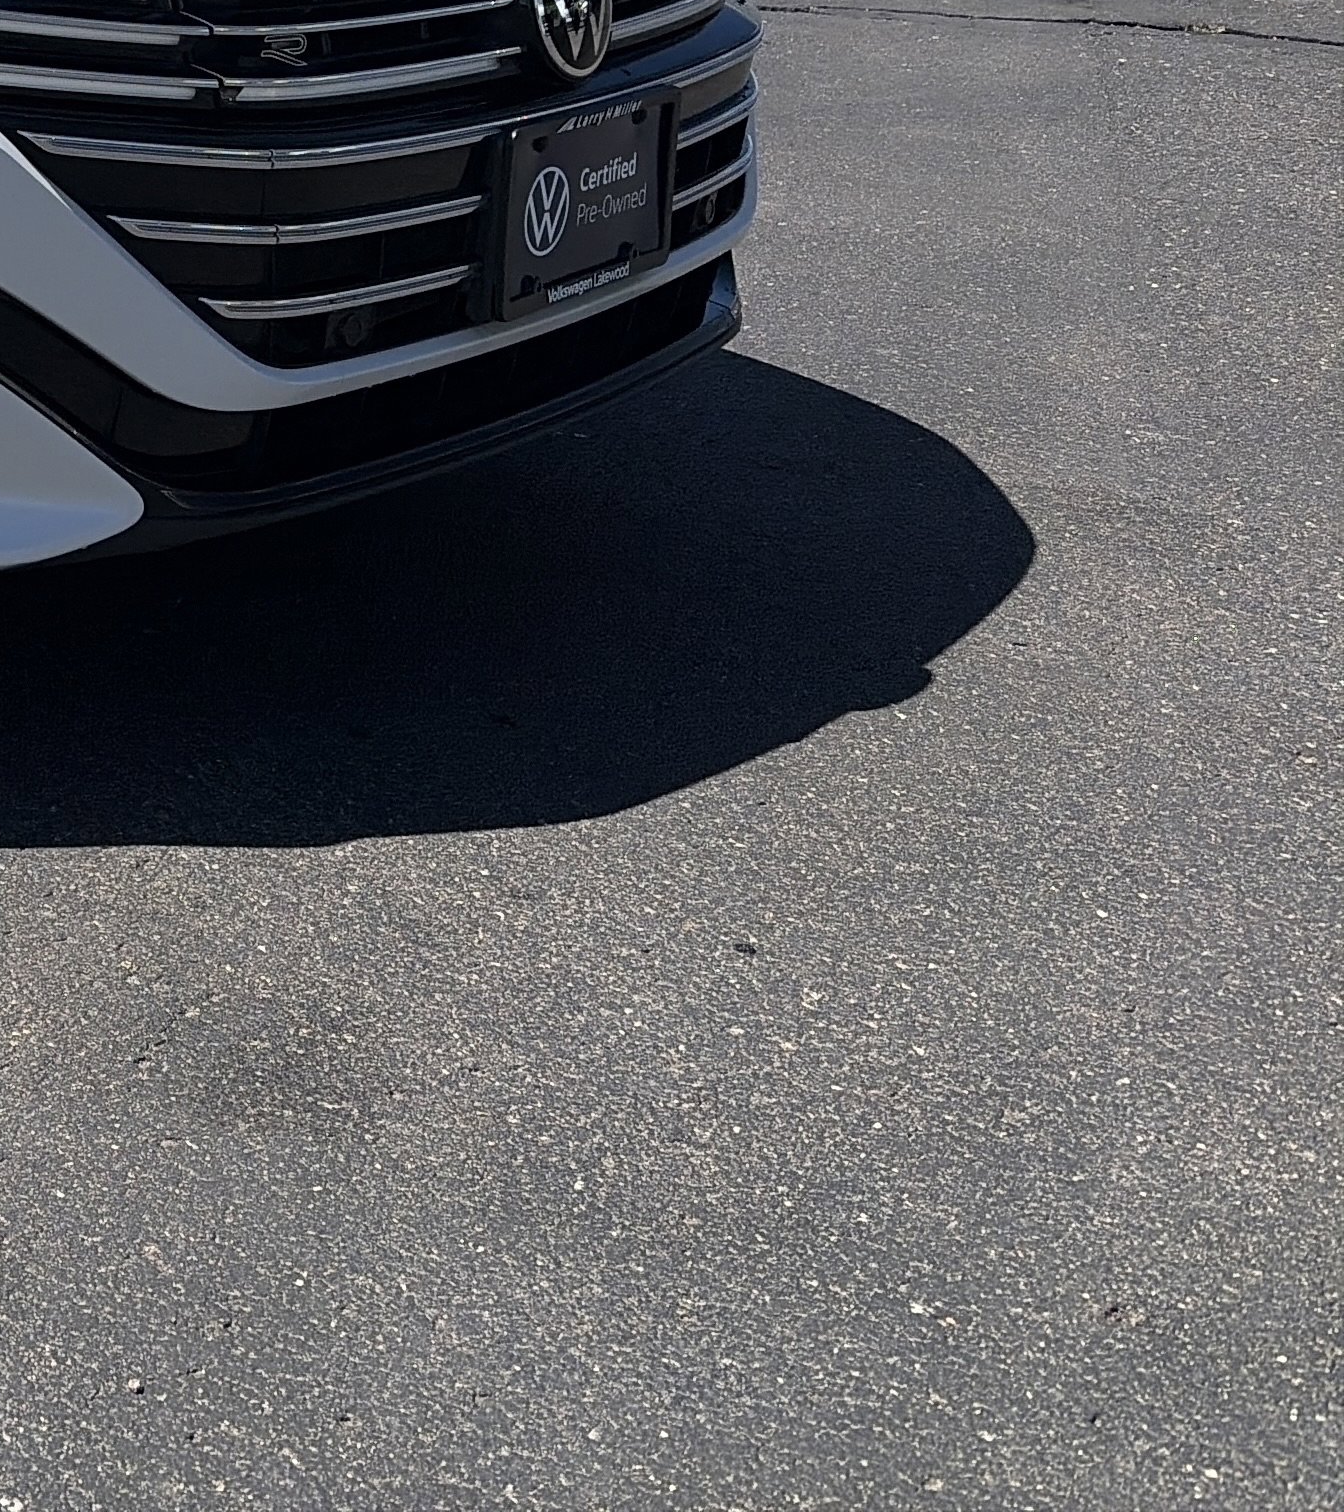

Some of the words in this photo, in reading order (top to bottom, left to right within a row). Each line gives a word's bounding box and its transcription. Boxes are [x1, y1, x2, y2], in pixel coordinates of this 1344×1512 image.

[261, 34, 308, 66] R
[576, 111, 606, 129] Larry
[613, 99, 642, 119] Miller
[580, 151, 637, 192] Certified
[527, 169, 568, 250] VW
[576, 181, 647, 227] Pre-Owned
[547, 277, 593, 304] Volkswagen
[593, 261, 630, 288] Lakewood
